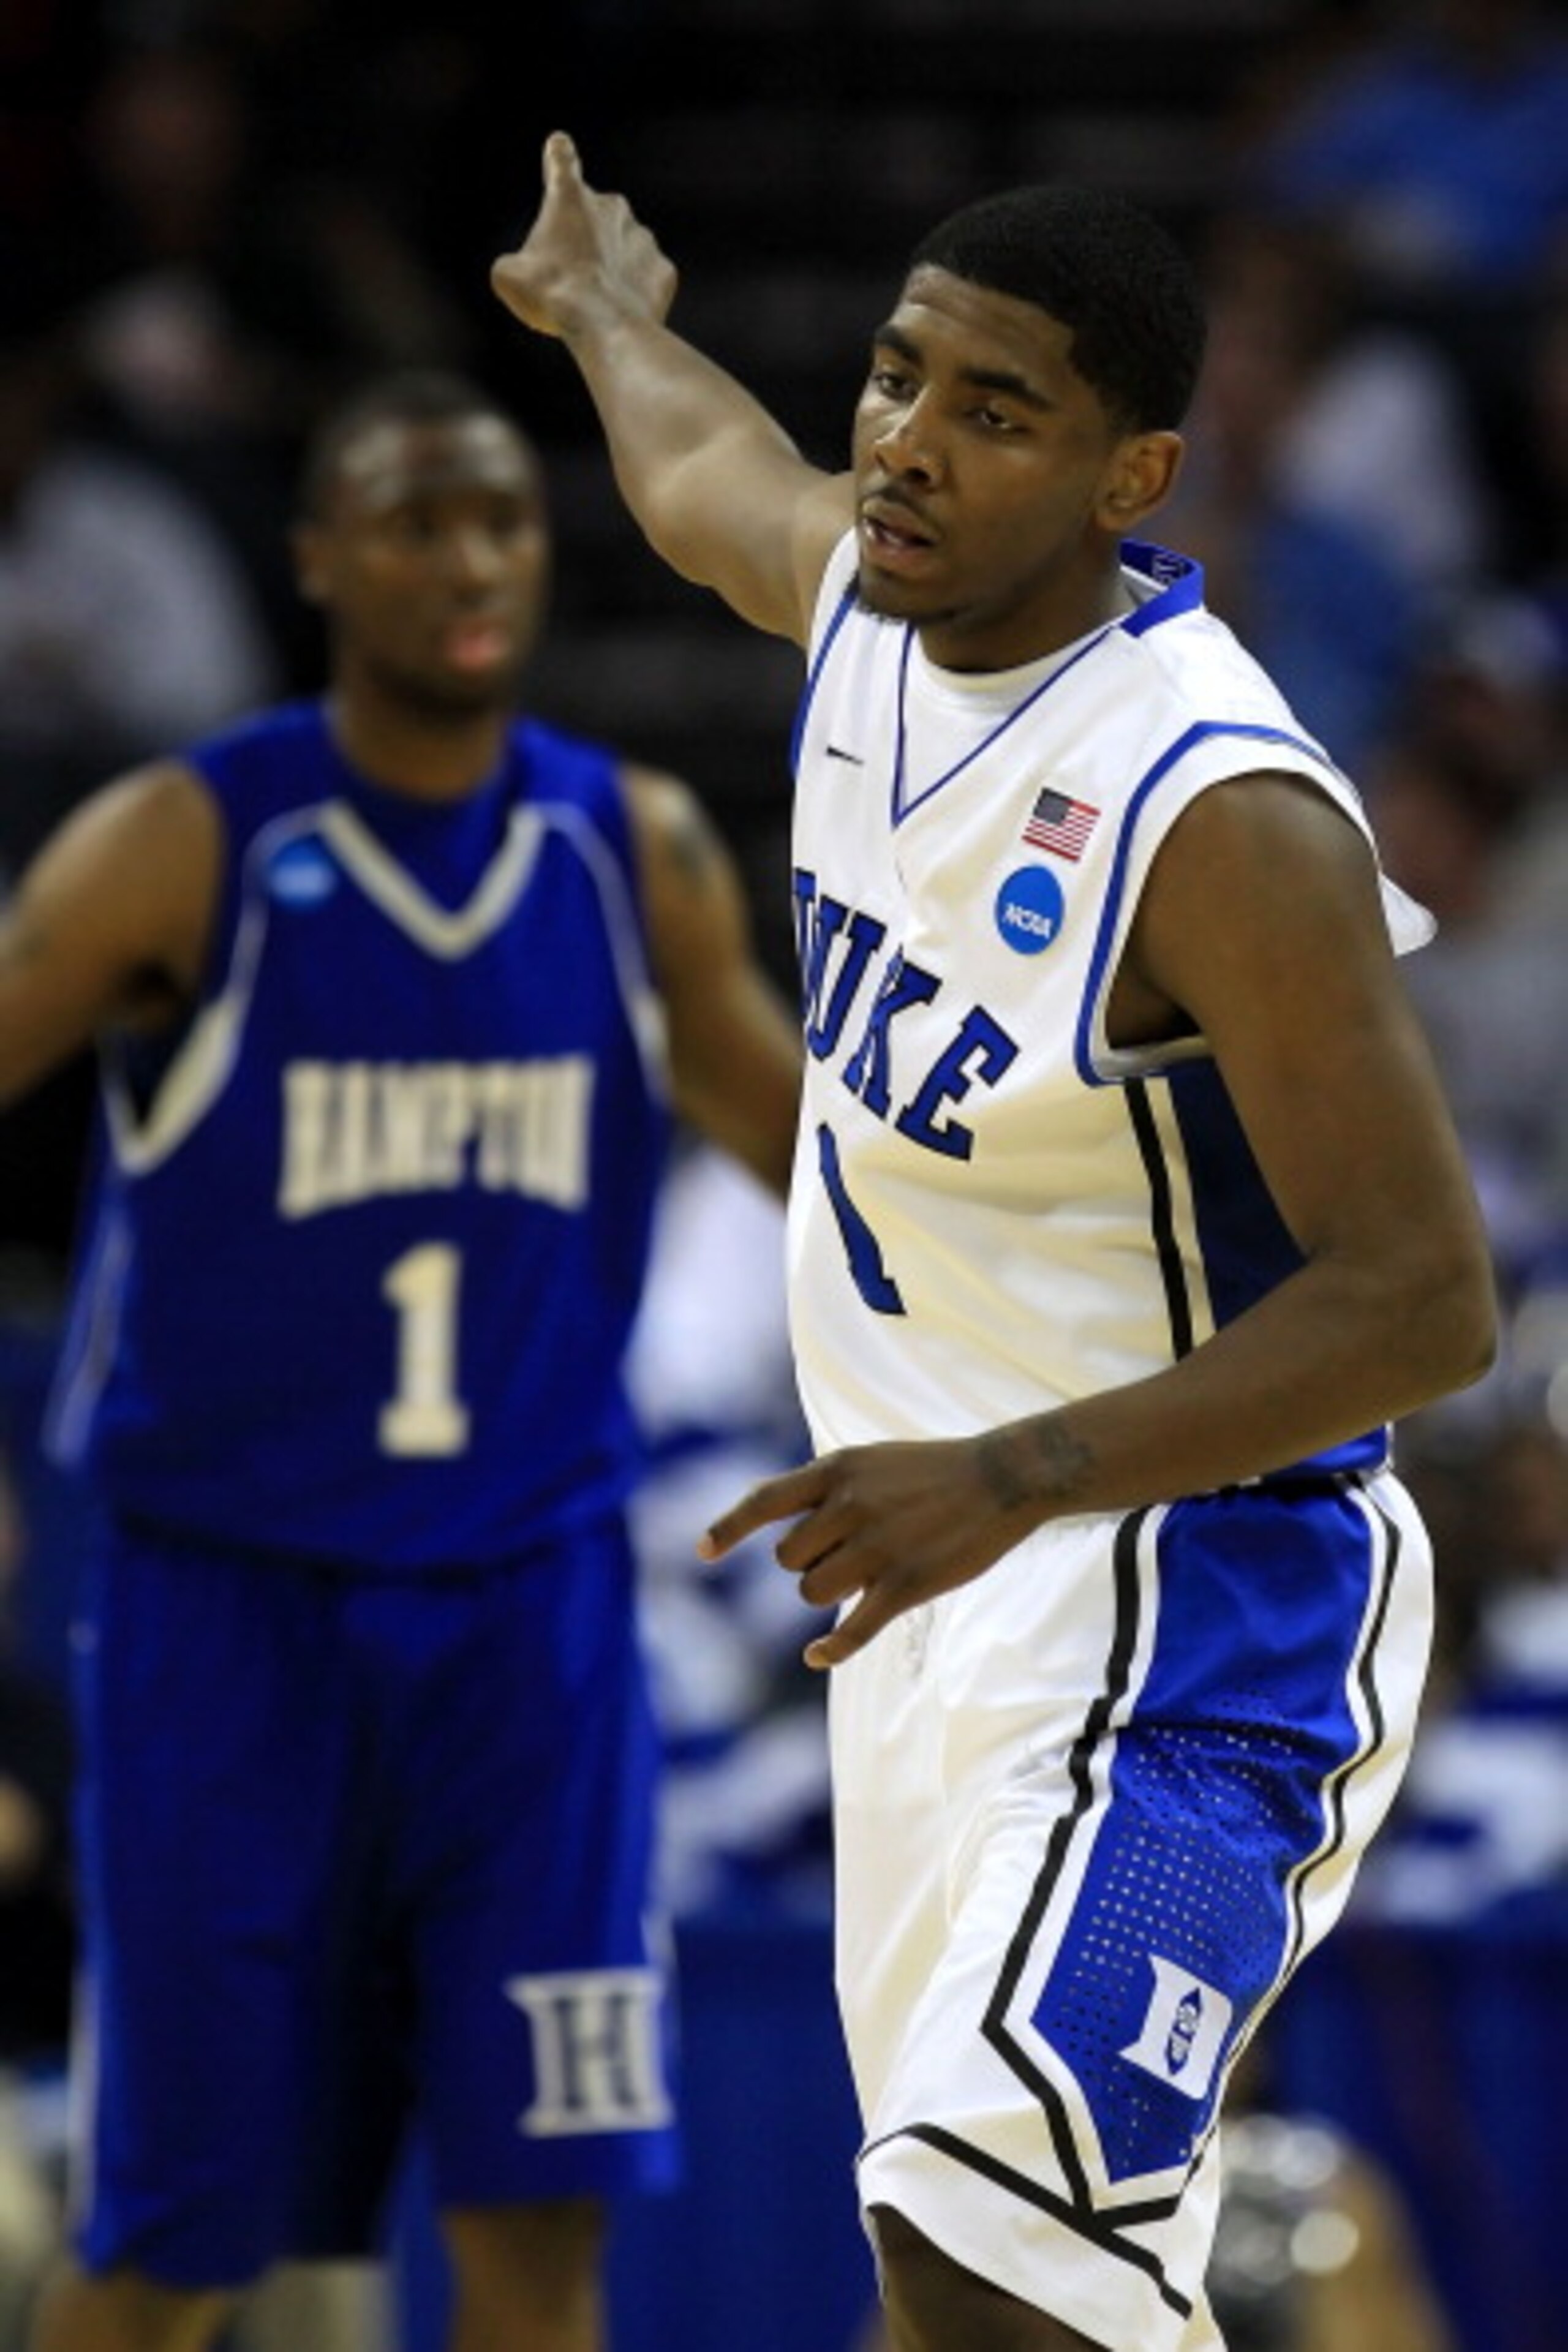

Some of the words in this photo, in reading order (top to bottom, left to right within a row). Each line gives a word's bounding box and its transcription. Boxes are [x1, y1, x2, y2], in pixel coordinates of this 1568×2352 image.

[1003, 902, 1051, 940] NCAA
[818, 1122, 906, 1315] 1
[380, 1243, 467, 1455] 1
[507, 1968, 672, 2135] H
